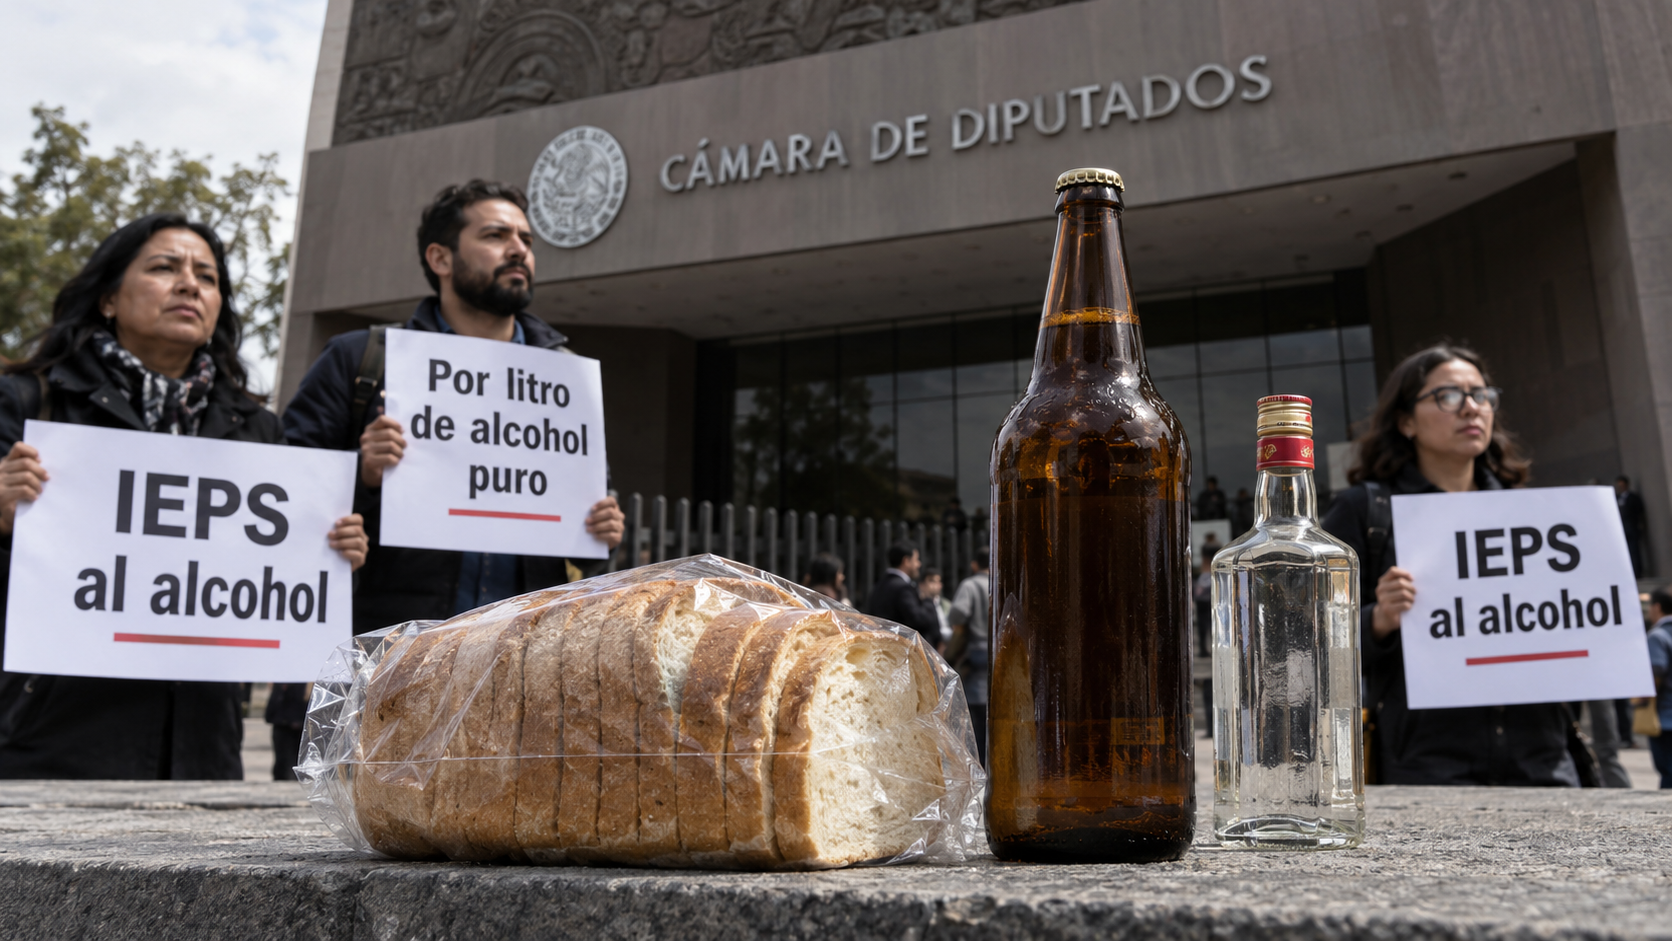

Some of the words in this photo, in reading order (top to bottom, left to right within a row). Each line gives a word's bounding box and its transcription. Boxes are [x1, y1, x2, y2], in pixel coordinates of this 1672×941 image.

[660, 130, 849, 193] CÁMARA
[870, 113, 930, 163] DE
[951, 54, 1273, 150] DIPUTADOS
[428, 358, 490, 396] Por
[507, 367, 571, 408] litro
[410, 404, 455, 441] de
[469, 411, 588, 456] alcohol
[115, 469, 289, 546] IEPS
[469, 464, 548, 499] puro
[1455, 522, 1581, 579] IEPS
[73, 554, 127, 612] al
[150, 560, 328, 623] alcohol
[1429, 596, 1465, 639] al
[1479, 584, 1622, 635] alcohol
